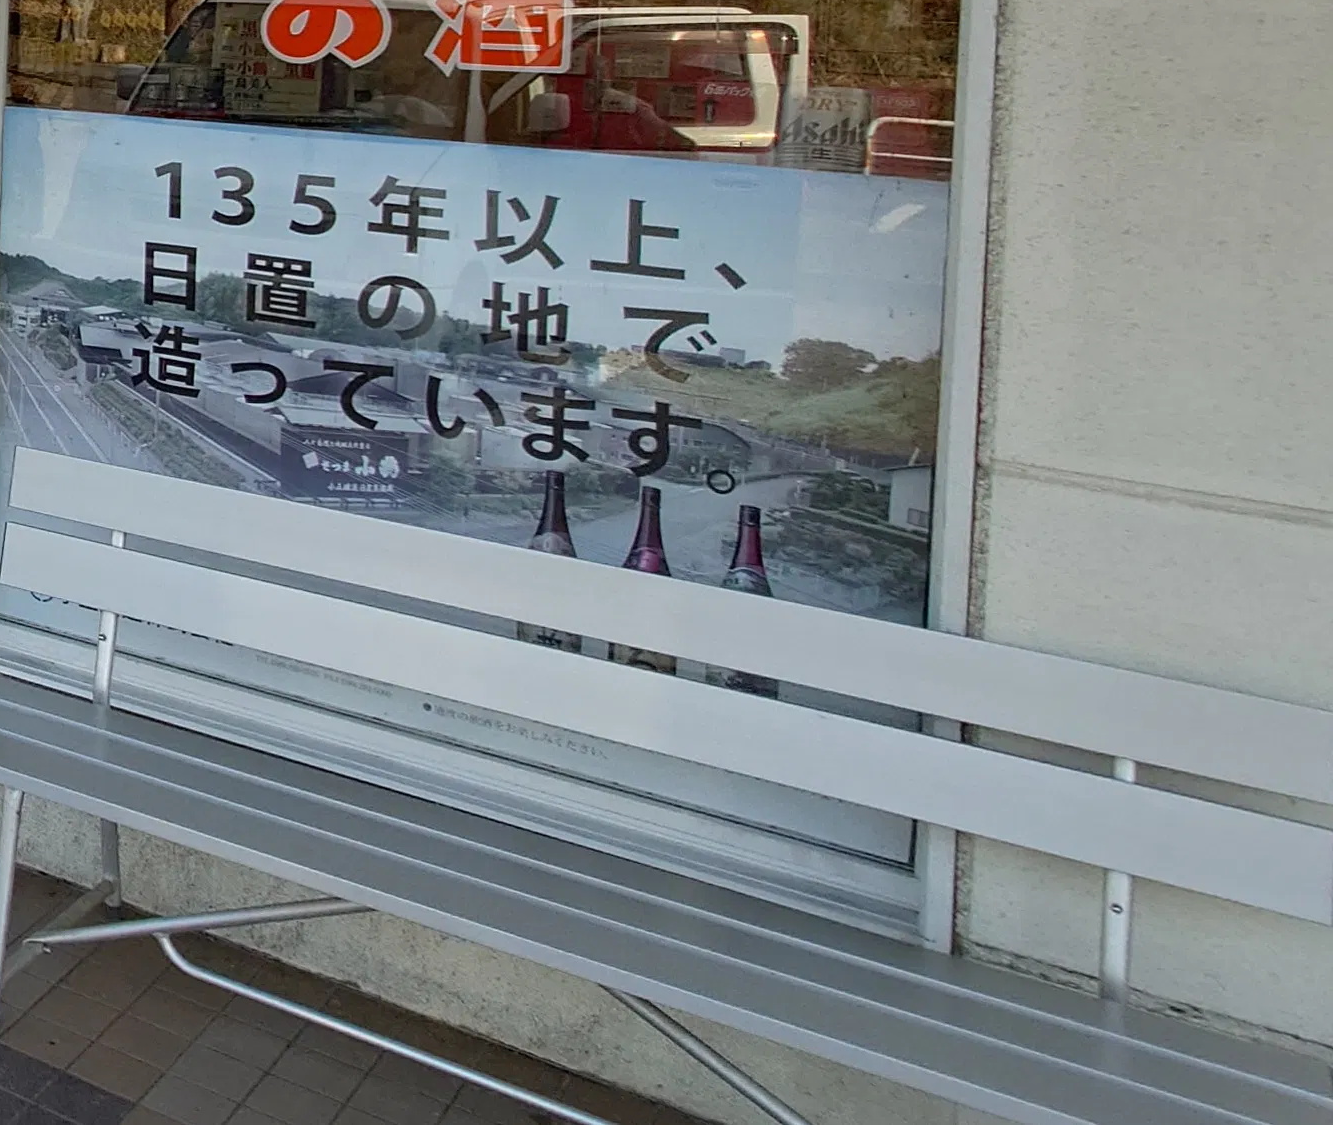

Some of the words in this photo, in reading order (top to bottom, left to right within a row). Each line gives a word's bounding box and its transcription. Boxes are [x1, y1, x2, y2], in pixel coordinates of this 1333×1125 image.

[155, 161, 749, 290] 135年以上、
[141, 241, 717, 383] 日置の地で
[133, 325, 737, 495] 造っています。
